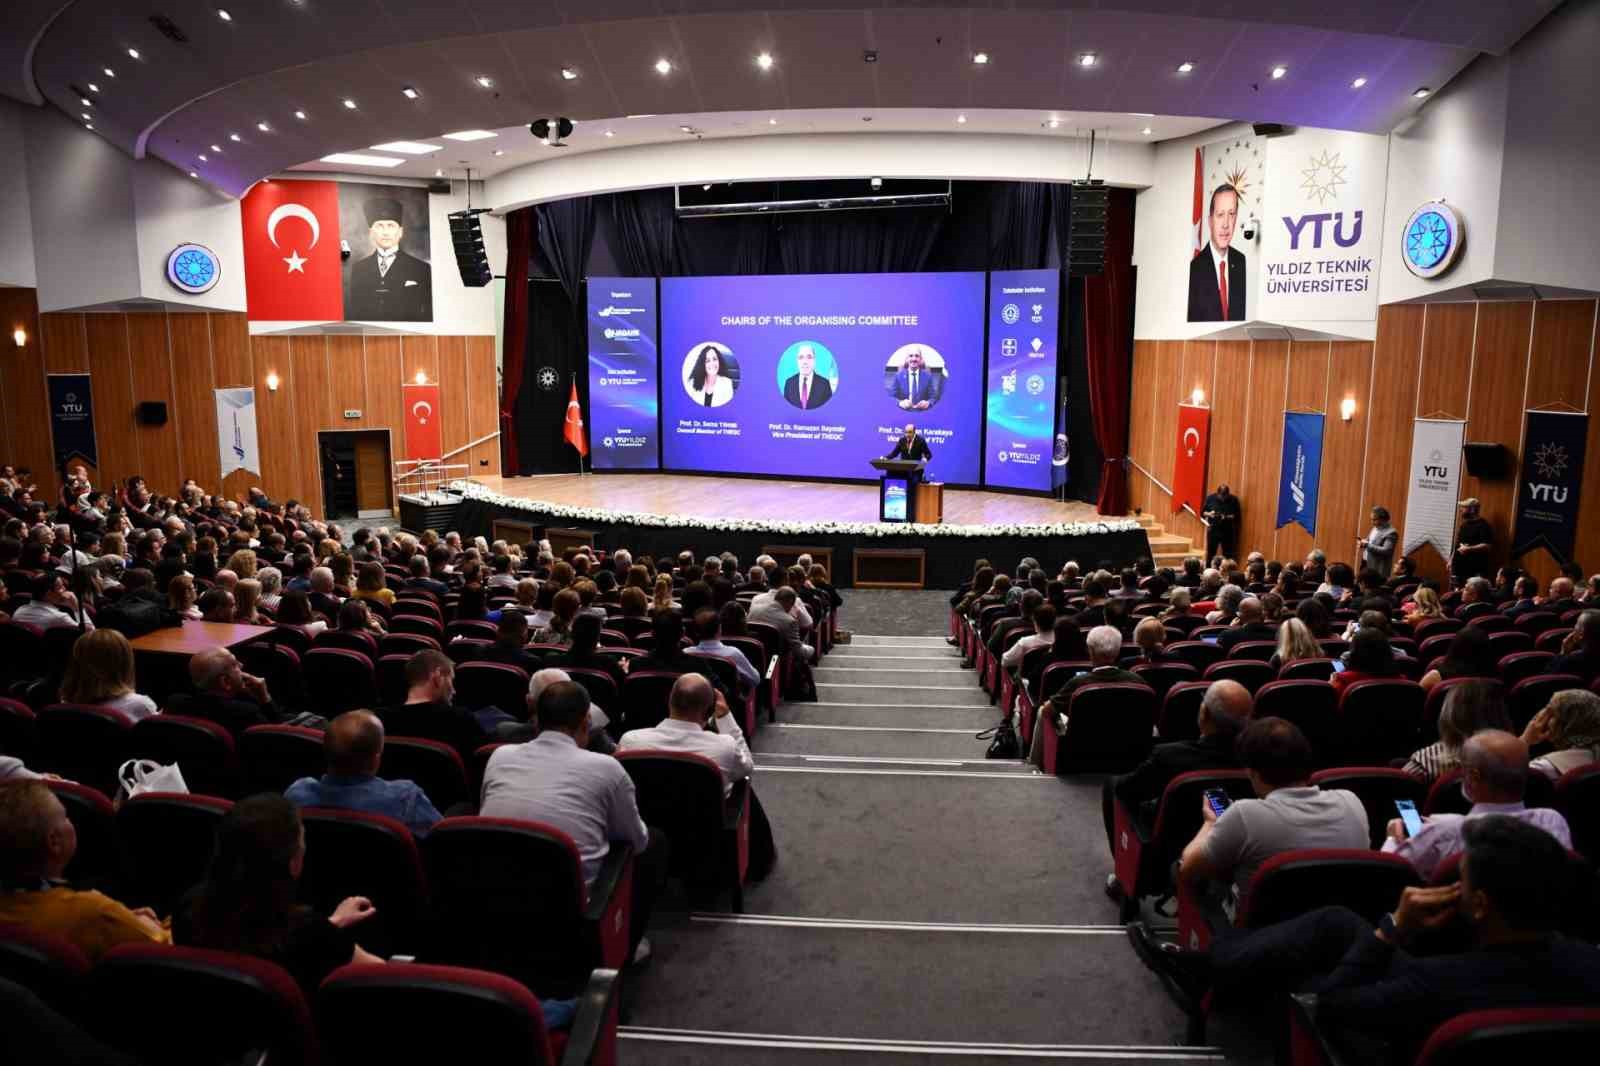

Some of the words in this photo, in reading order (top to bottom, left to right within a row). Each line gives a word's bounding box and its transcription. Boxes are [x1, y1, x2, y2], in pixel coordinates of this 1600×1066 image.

[1267, 262, 1312, 276] YILDIZ
[1317, 256, 1372, 274] TEKNİK
[1267, 275, 1368, 294] ÜNİVERSİTESİ
[721, 315, 757, 326] CHAIRS
[758, 315, 772, 326] OF
[774, 315, 793, 326] THE
[794, 315, 856, 326] ORGANISING
[858, 315, 919, 326] COMMITTEE
